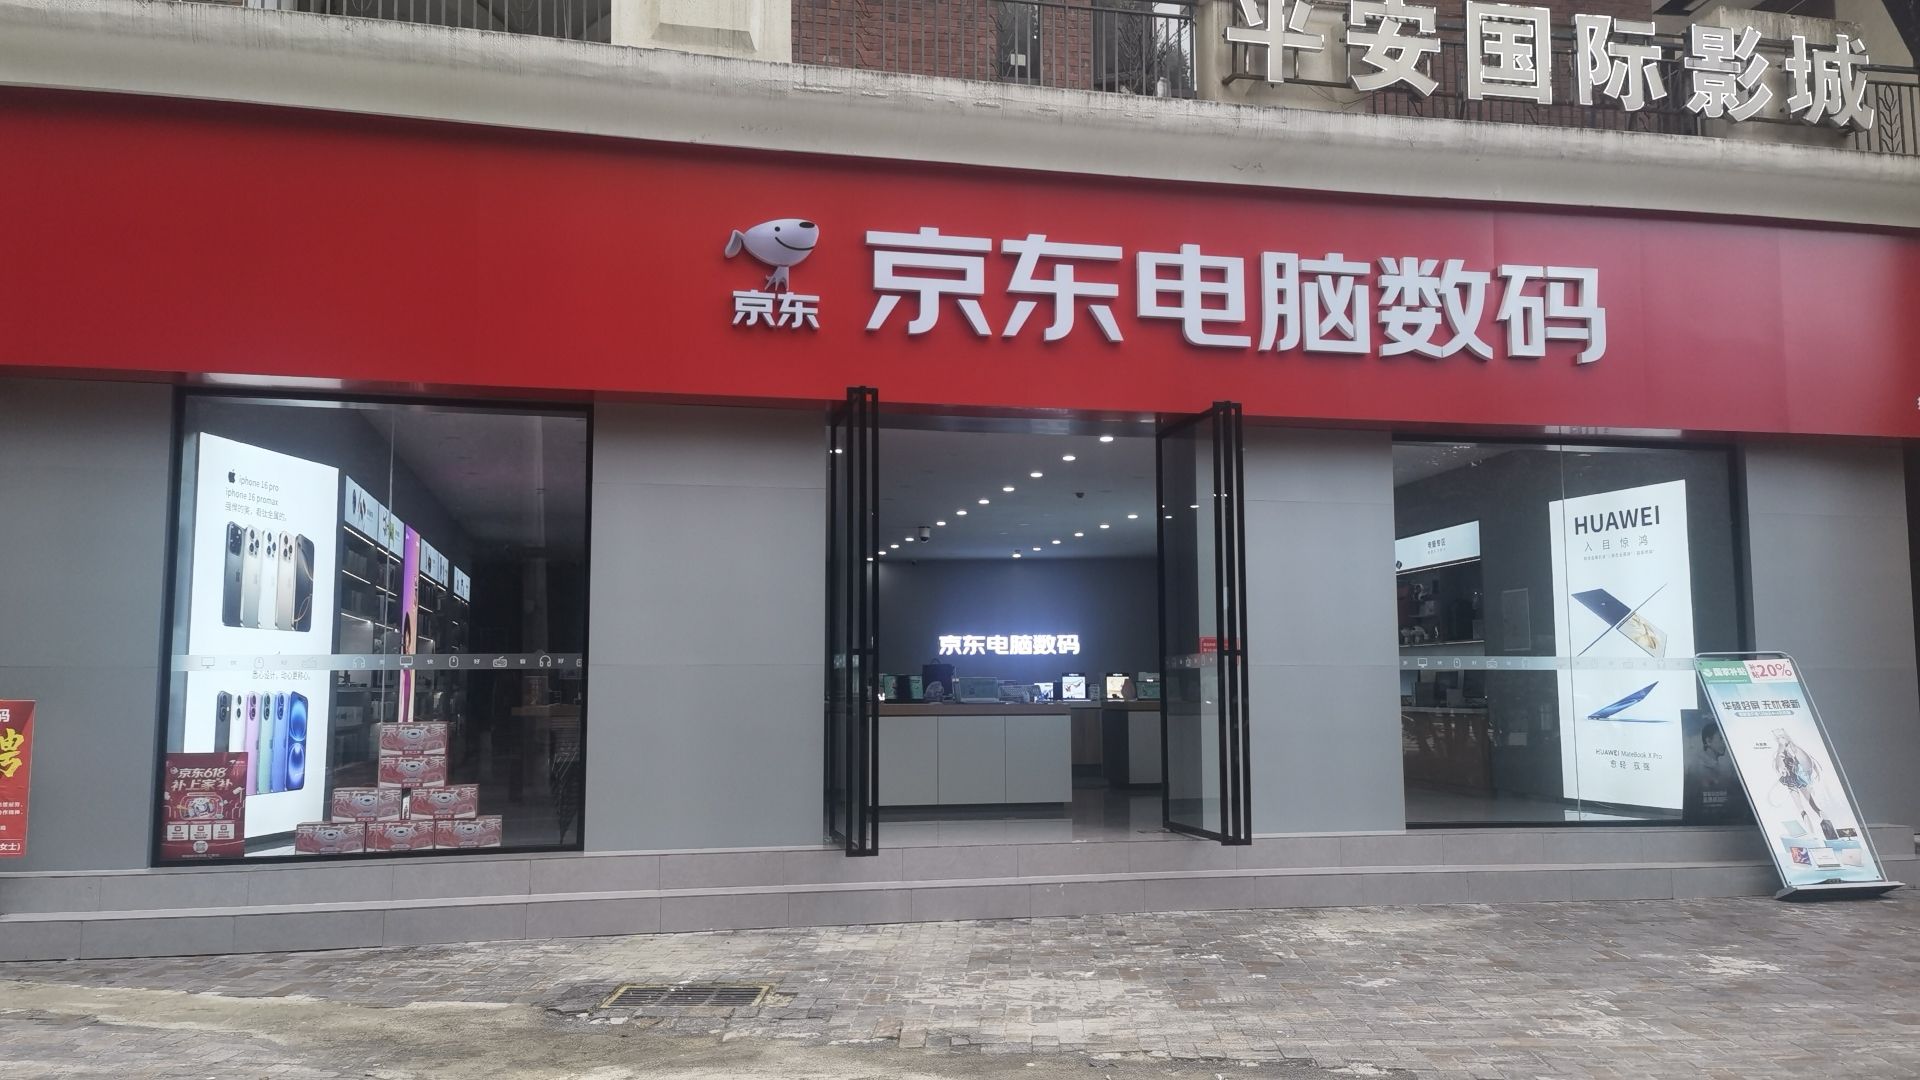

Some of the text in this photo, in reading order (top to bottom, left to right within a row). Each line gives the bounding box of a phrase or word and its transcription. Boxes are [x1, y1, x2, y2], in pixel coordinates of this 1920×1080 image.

[1225, 0, 1876, 132] 平安国际影城
[865, 226, 1608, 366] 京东电脑数码
[732, 289, 820, 330] 京东
[239, 475, 279, 492] iphone 16 pro
[225, 487, 278, 505] iphone 16 promax
[1574, 505, 1660, 535] HUAWEI
[1584, 534, 1649, 552] 入目惊鸿
[938, 634, 1081, 656] 京东电脑数码
[1757, 663, 1792, 677] 20%
[1595, 749, 1620, 757] HUAWEI
[178, 767, 229, 779] 京东618
